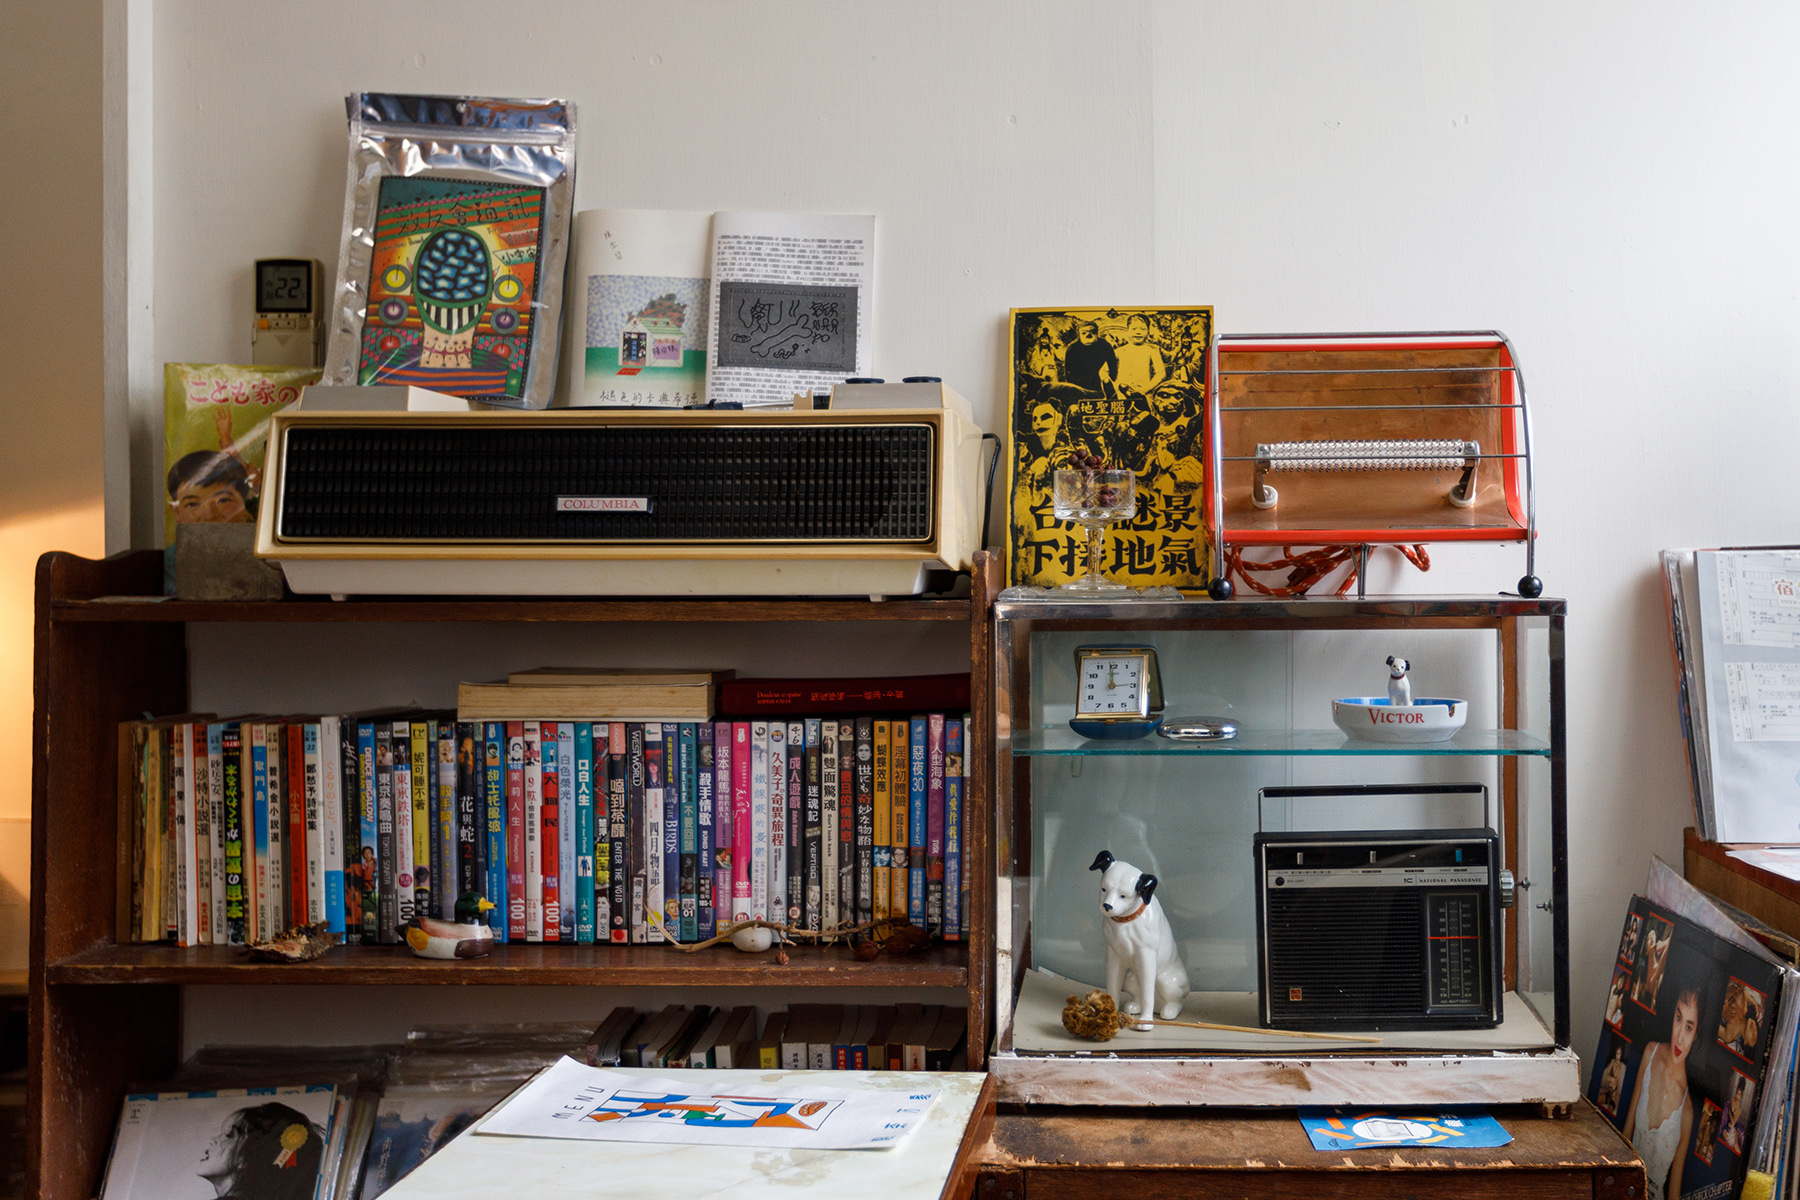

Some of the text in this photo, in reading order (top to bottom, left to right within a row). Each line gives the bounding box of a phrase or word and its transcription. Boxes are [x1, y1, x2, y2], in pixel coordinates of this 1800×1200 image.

[275, 278, 301, 299] 22
[563, 499, 640, 509] COLUMBIA
[1021, 535, 1203, 577] 下接地氣
[560, 754, 571, 801] 白色榮光
[631, 729, 642, 787] WESTWORLD
[717, 746, 729, 794] 坂本龍馬
[876, 744, 888, 793] 蝴蝶效應
[894, 745, 907, 807] 淫幕初體驗
[912, 745, 925, 792] 惡夜30
[930, 742, 943, 790] 人型海象
[364, 746, 374, 823] DEUCE BIGALOW
[378, 773, 393, 834] 東京奏鳴曲
[486, 769, 501, 833] 胡士托風波
[511, 772, 521, 826] 茉莉人生
[578, 759, 590, 807] 口白人生
[699, 772, 712, 826] 殺手情歌
[789, 757, 801, 809] 成人遊戲
[808, 785, 819, 822] 迷魂記
[823, 758, 836, 812] 雙面驚魂
[857, 764, 873, 846] 世にも奇妙な物語
[461, 795, 475, 858] 花與蛇 2
[665, 820, 678, 854] BIRDS
[684, 805, 694, 852] 不要回頭
[931, 839, 940, 854] TUSK
[383, 836, 391, 885] TOKYO SONATA
[614, 841, 623, 904] ENTER THE VOID
[400, 899, 415, 920] 100
[510, 898, 525, 920] 100
[545, 900, 560, 923] 100
[551, 1085, 605, 1119] MENU
[1707, 1179, 1733, 1198] CHAPTER
